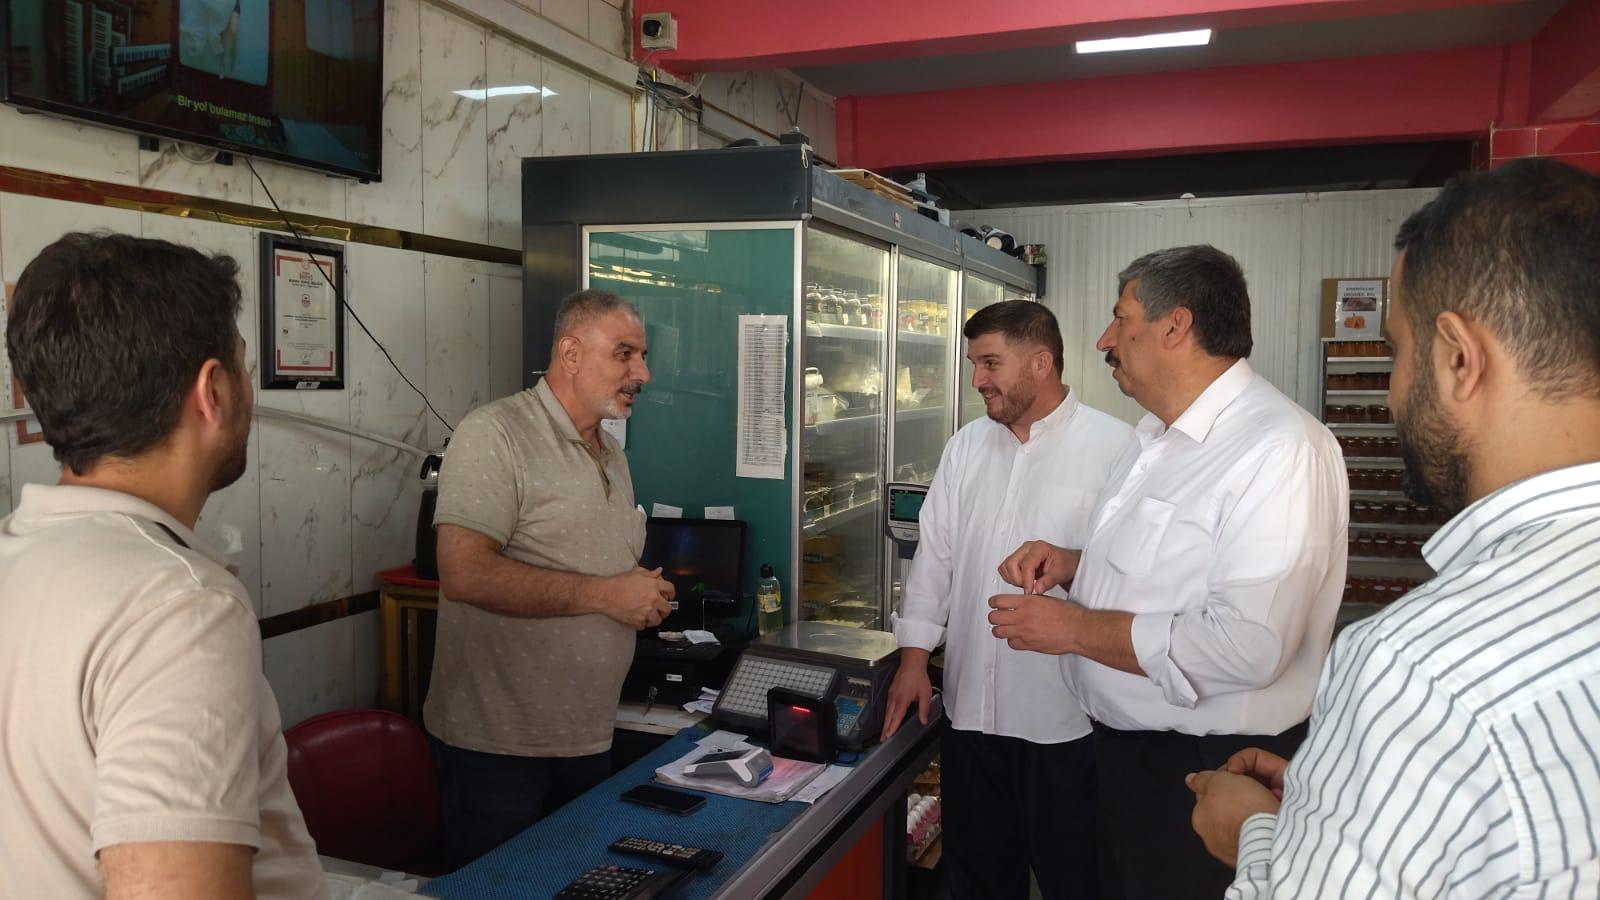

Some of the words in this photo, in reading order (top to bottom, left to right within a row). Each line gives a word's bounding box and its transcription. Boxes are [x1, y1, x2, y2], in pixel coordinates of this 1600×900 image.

[177, 94, 192, 108] Bir
[193, 101, 208, 112] yol
[208, 102, 247, 121] bulamaz
